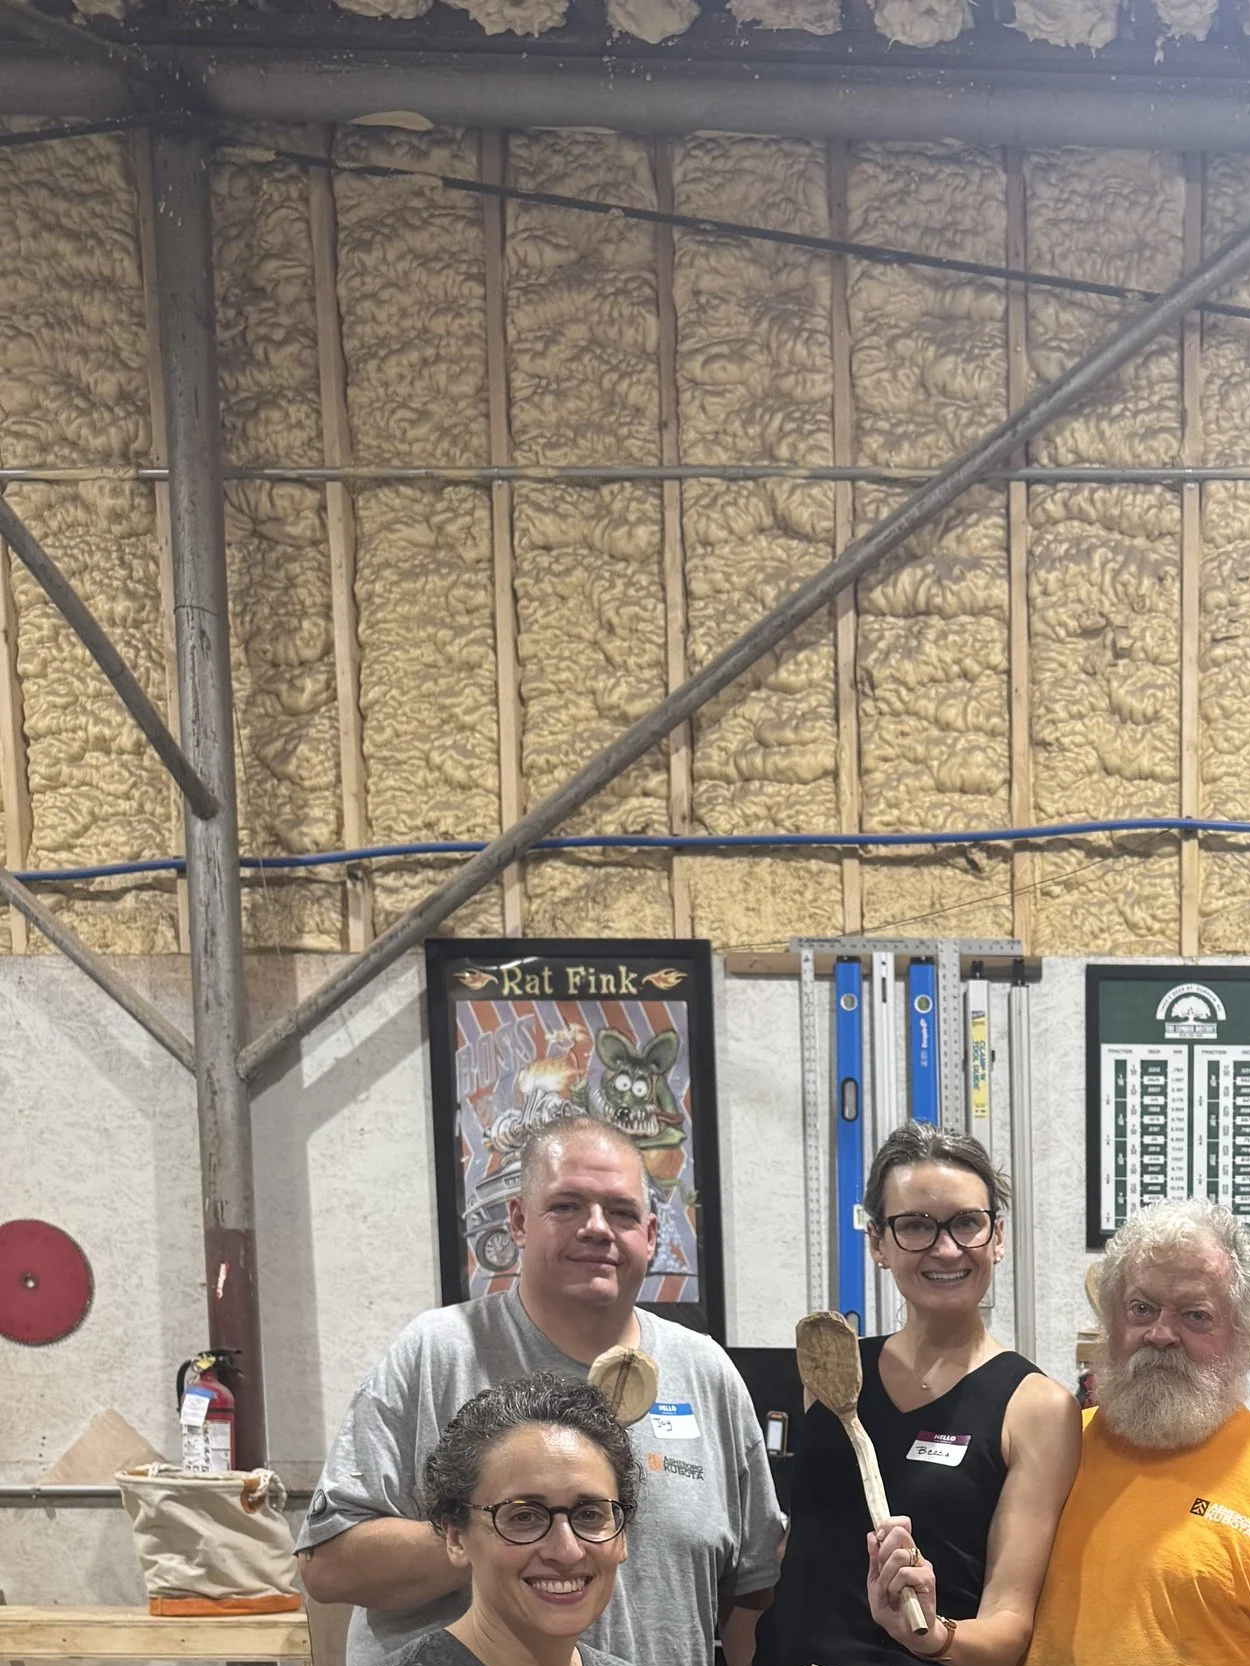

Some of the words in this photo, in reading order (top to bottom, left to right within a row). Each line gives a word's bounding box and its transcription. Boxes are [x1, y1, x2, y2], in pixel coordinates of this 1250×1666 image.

[501, 967, 553, 996] Rat
[566, 966, 638, 995] Fink
[934, 1434, 957, 1442] HELLO
